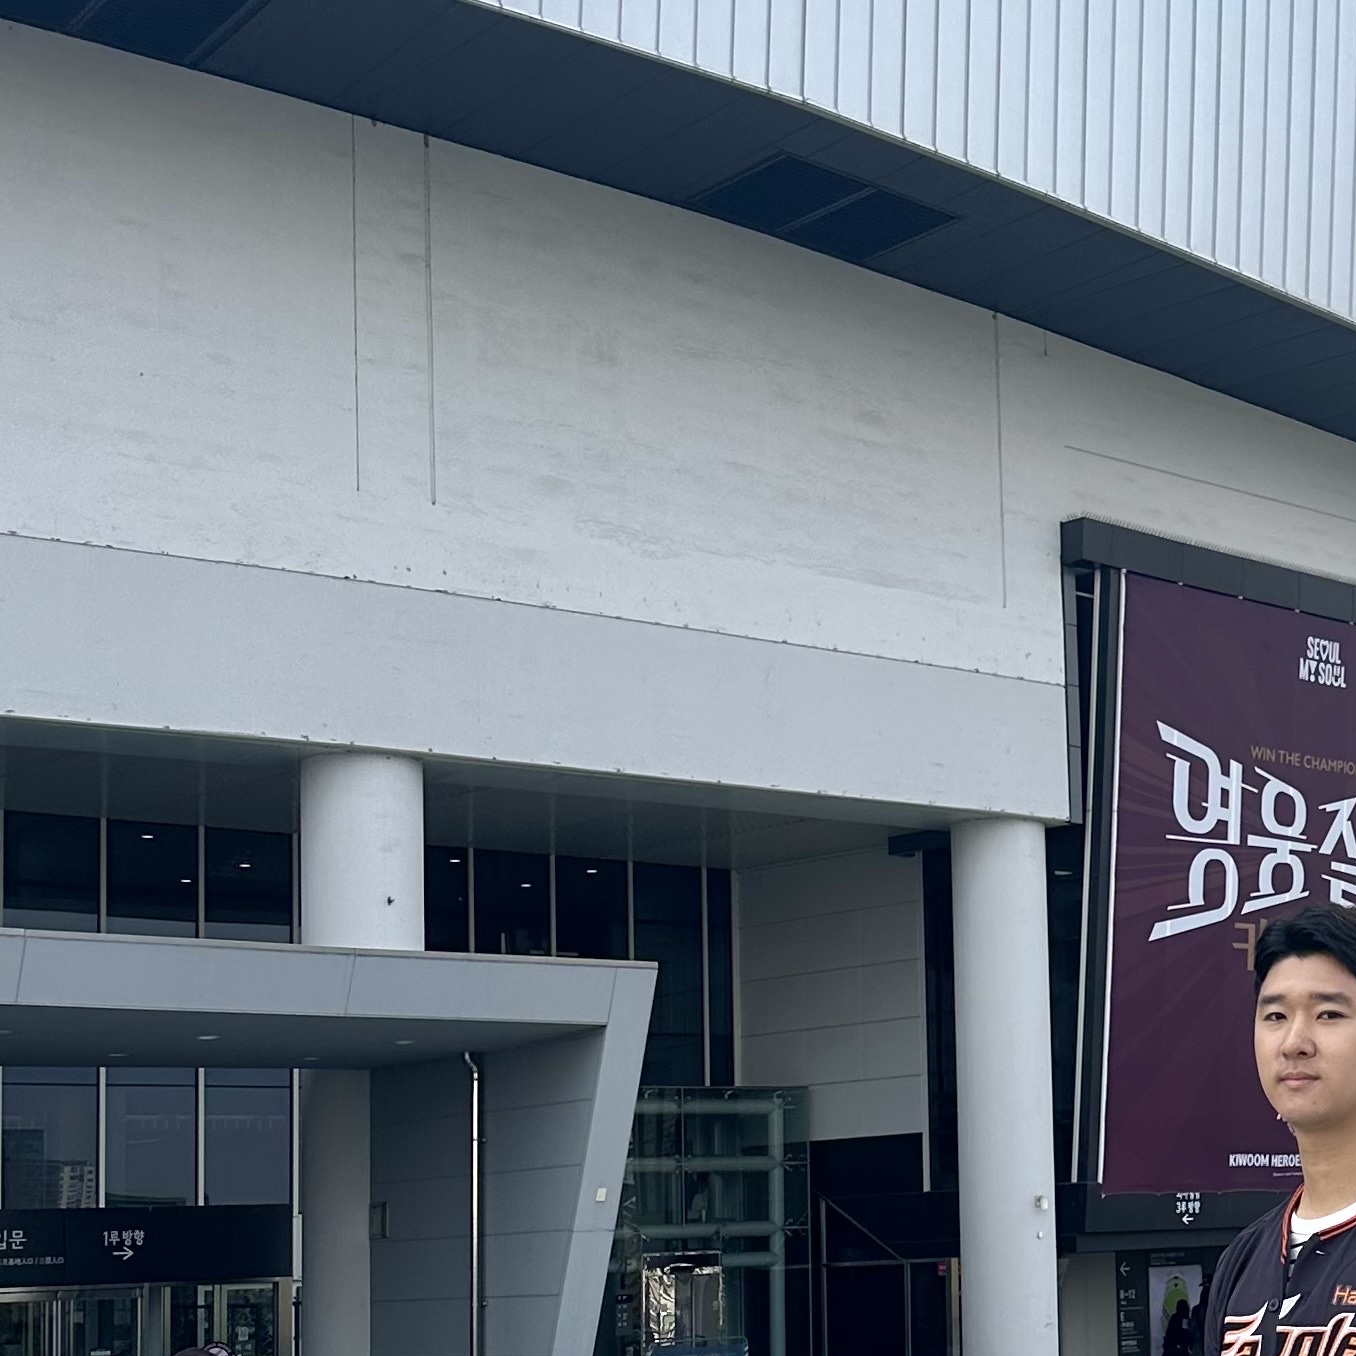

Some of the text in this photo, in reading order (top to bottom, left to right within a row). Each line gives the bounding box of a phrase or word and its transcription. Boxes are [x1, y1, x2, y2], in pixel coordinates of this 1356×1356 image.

[1250, 745, 1276, 762] WIN
[1278, 750, 1301, 766] THE
[1228, 1153, 1303, 1168] KIWOOM HEROE
[103, 1229, 145, 1246] 1루 방향
